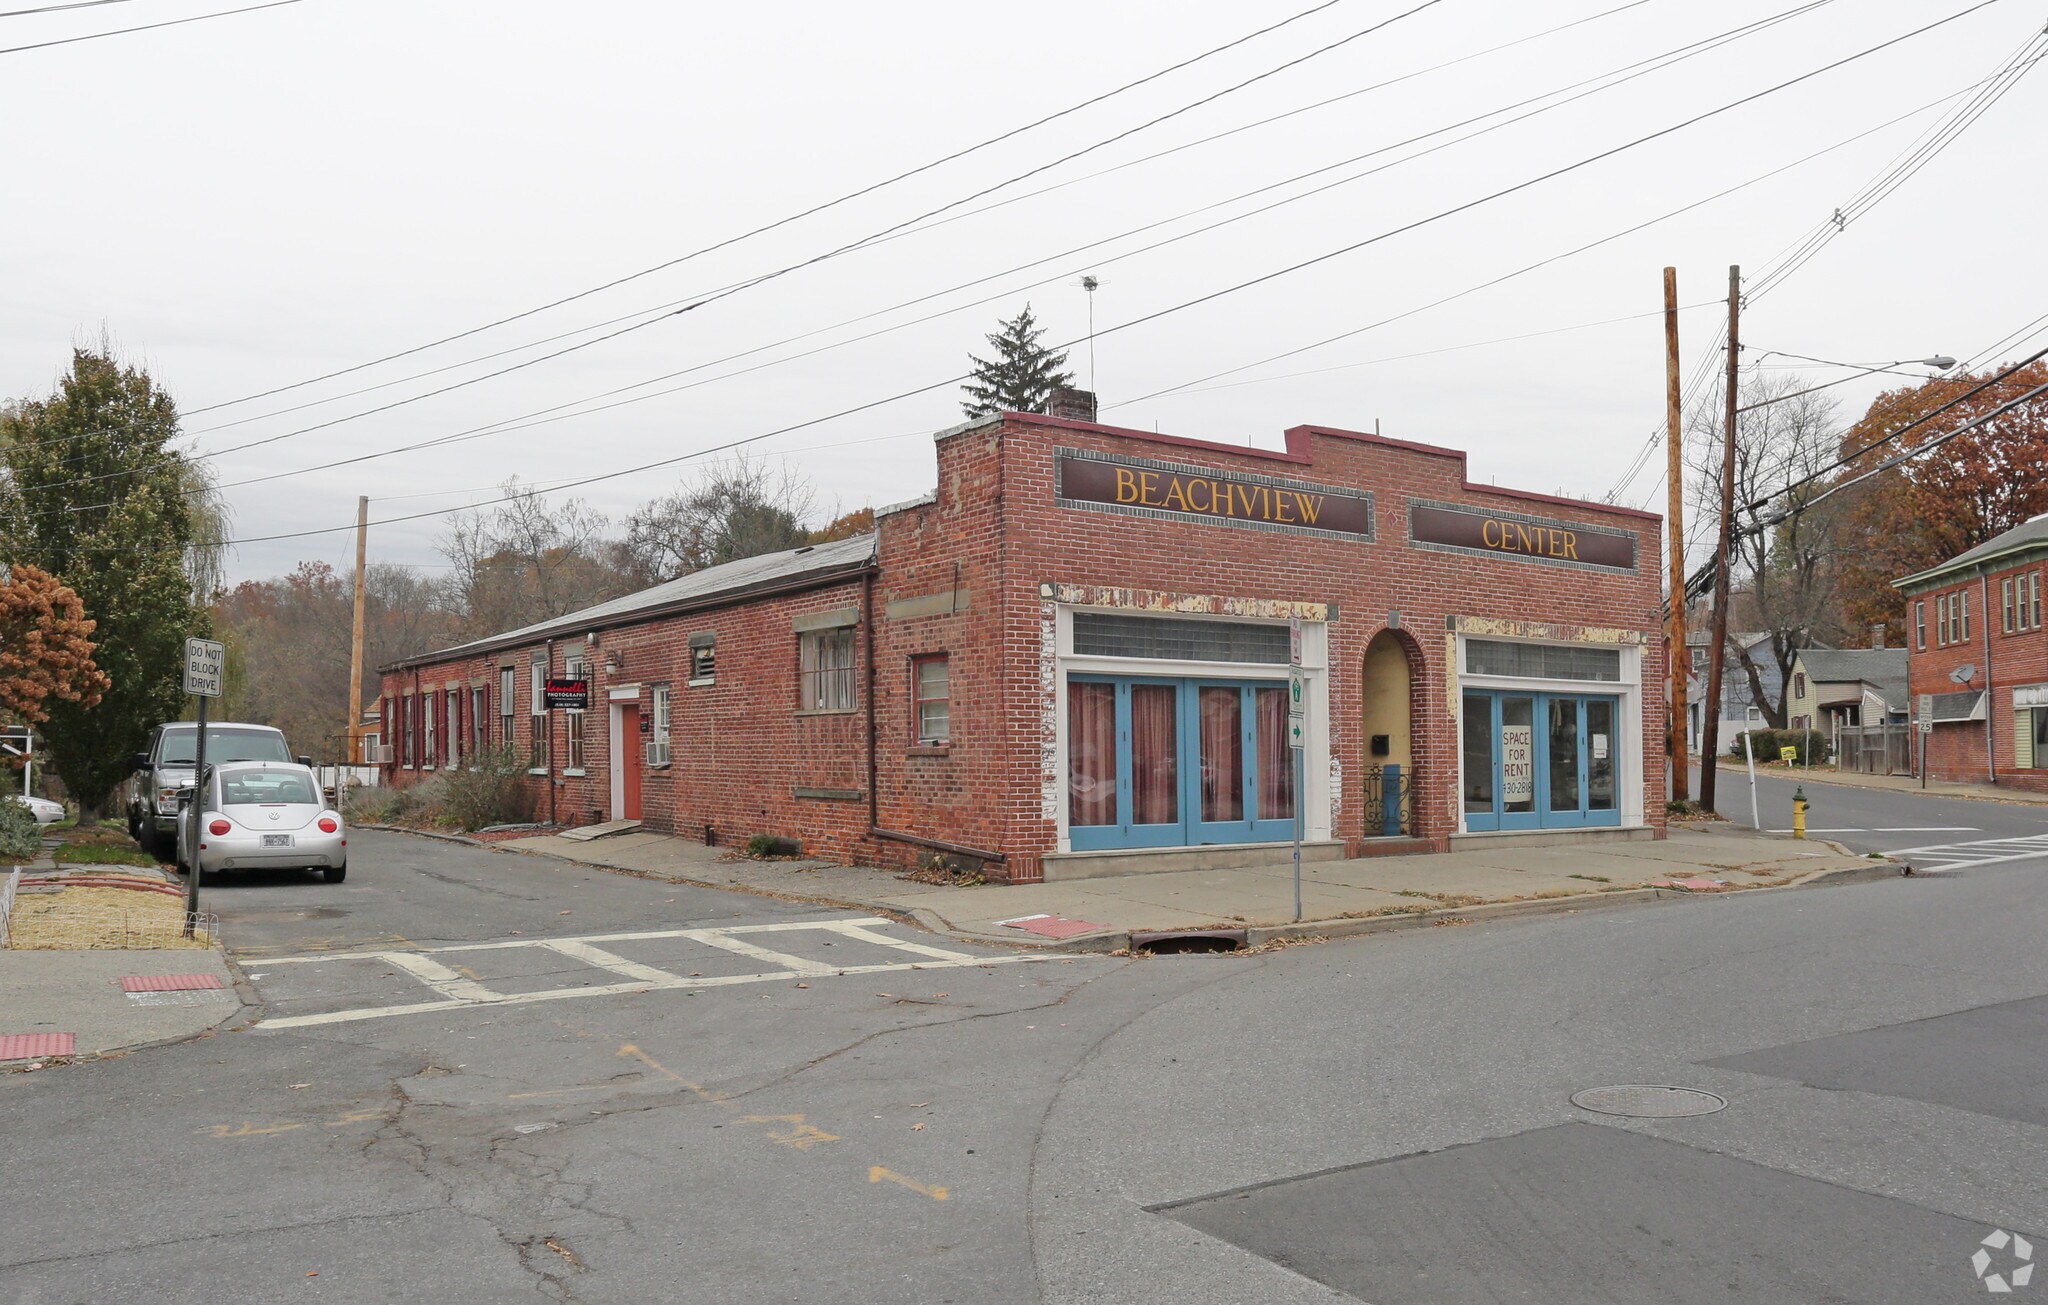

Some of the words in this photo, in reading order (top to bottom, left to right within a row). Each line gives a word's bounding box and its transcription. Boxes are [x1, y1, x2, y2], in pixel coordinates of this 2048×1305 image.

[1115, 467, 1324, 524] BEACHVIEW
[1482, 519, 1578, 560] CENTER
[190, 645, 203, 657] DO
[204, 649, 222, 660] NOT
[191, 661, 219, 676] BLOCK
[191, 677, 216, 691] DRIVE
[1920, 723, 1931, 731] 25
[1503, 732, 1529, 746] SPACE
[1508, 749, 1525, 760] FOR
[1504, 763, 1529, 777] RENT
